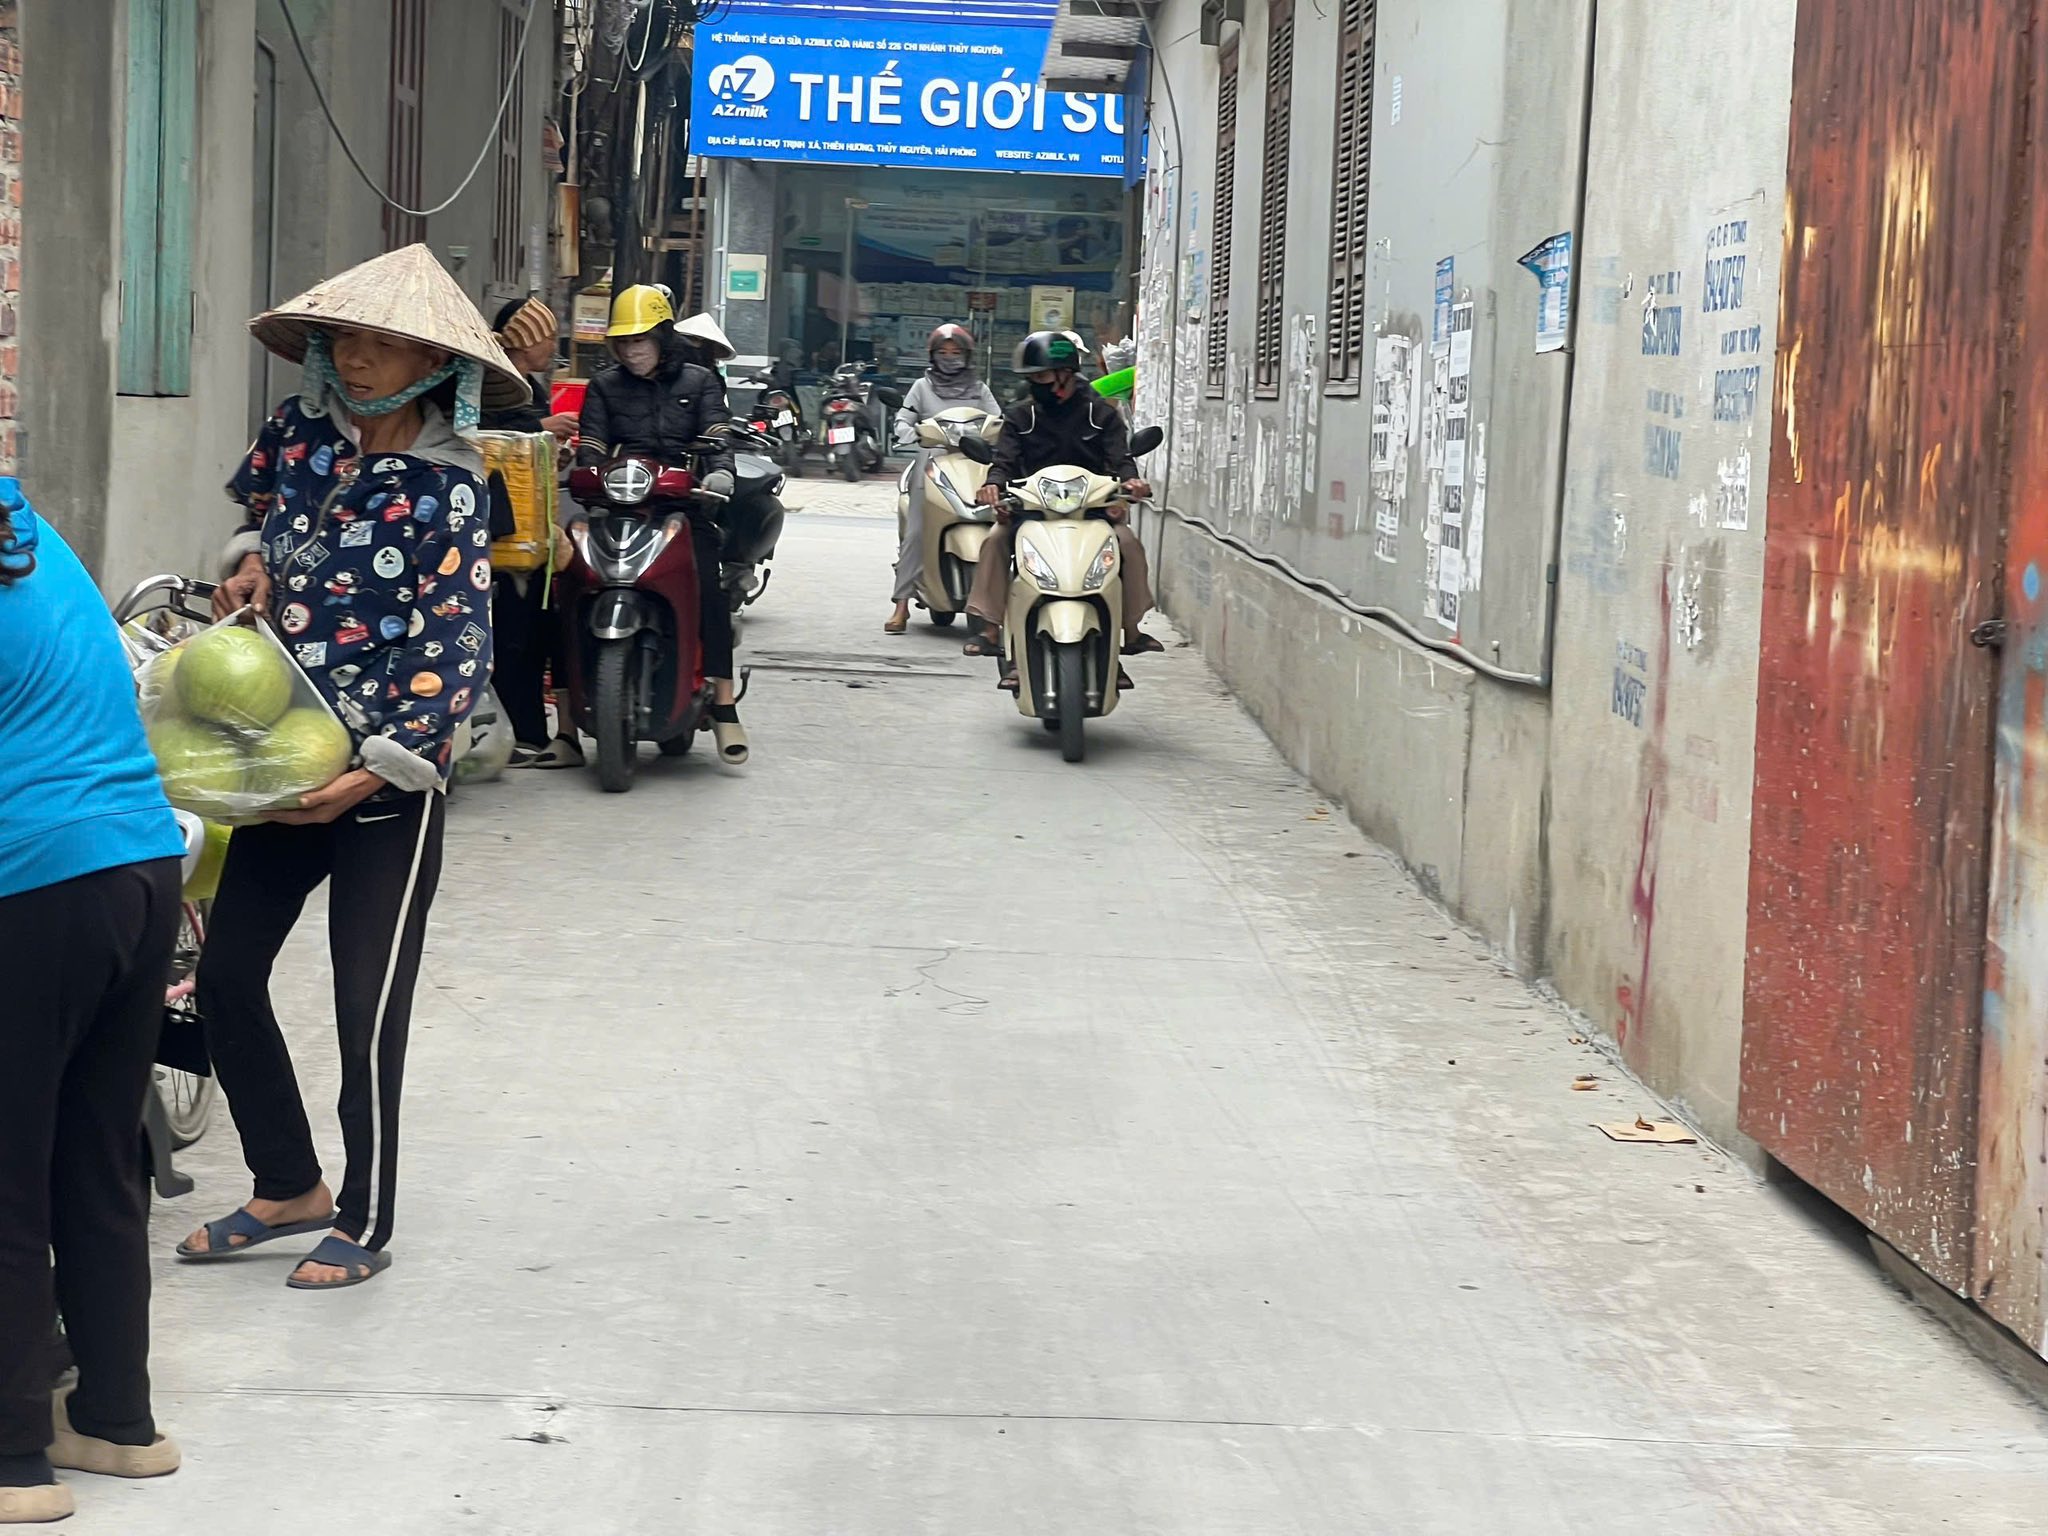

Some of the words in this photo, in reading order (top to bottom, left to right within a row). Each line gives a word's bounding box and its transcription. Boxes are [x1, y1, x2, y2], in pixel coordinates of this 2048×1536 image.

[711, 32, 723, 44] HỆ
[723, 31, 751, 43] THỐNG
[751, 33, 767, 44] THẾ
[876, 38, 887, 50] SỐ
[903, 42, 918, 51] CHI
[918, 42, 946, 52] NHÁNH
[970, 45, 1003, 55] NGUYÊN
[789, 59, 903, 125] THẾ
[920, 67, 1046, 132] GIỚI
[711, 103, 769, 119] AZmilk
[707, 136, 722, 145] ĐỊA
[756, 139, 763, 147] 3
[782, 139, 806, 150] TRỊNH
[1068, 153, 1080, 161] VN
